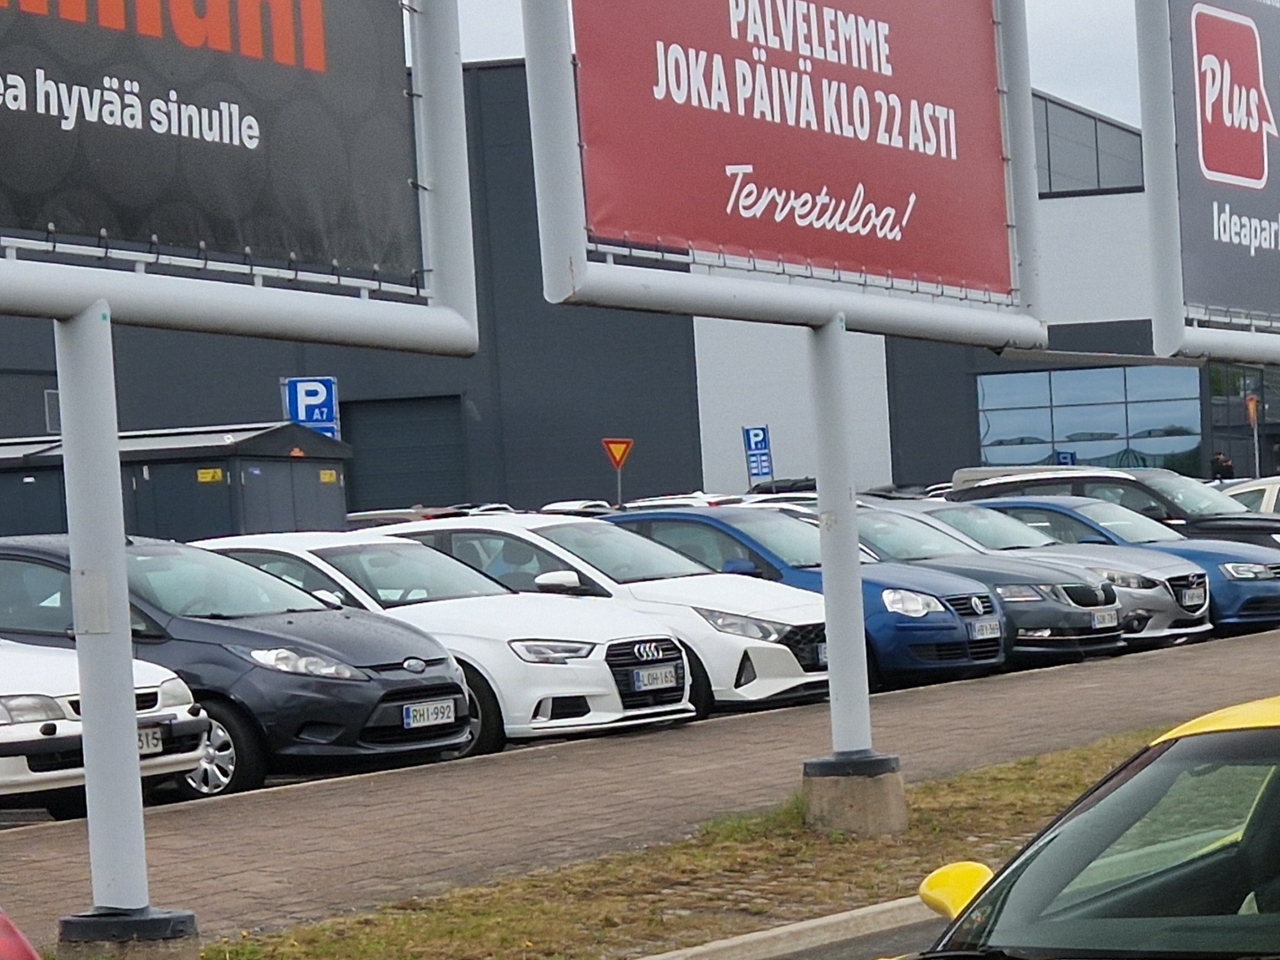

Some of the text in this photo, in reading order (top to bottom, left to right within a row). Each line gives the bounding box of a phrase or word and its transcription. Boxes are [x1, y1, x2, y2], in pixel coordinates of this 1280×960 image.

[729, 0, 892, 76] PALVELEMME
[36, 68, 142, 130] hyvää
[150, 89, 260, 149] sinulle
[653, 40, 957, 160] JOKA PÄIVÄ KLO 22 ASTI
[1201, 54, 1260, 132] Plus
[725, 164, 917, 242] Tervetuloa!
[297, 381, 327, 420] P
[313, 407, 328, 420] A7
[749, 429, 764, 450] P
[411, 704, 453, 724] RHI-992
